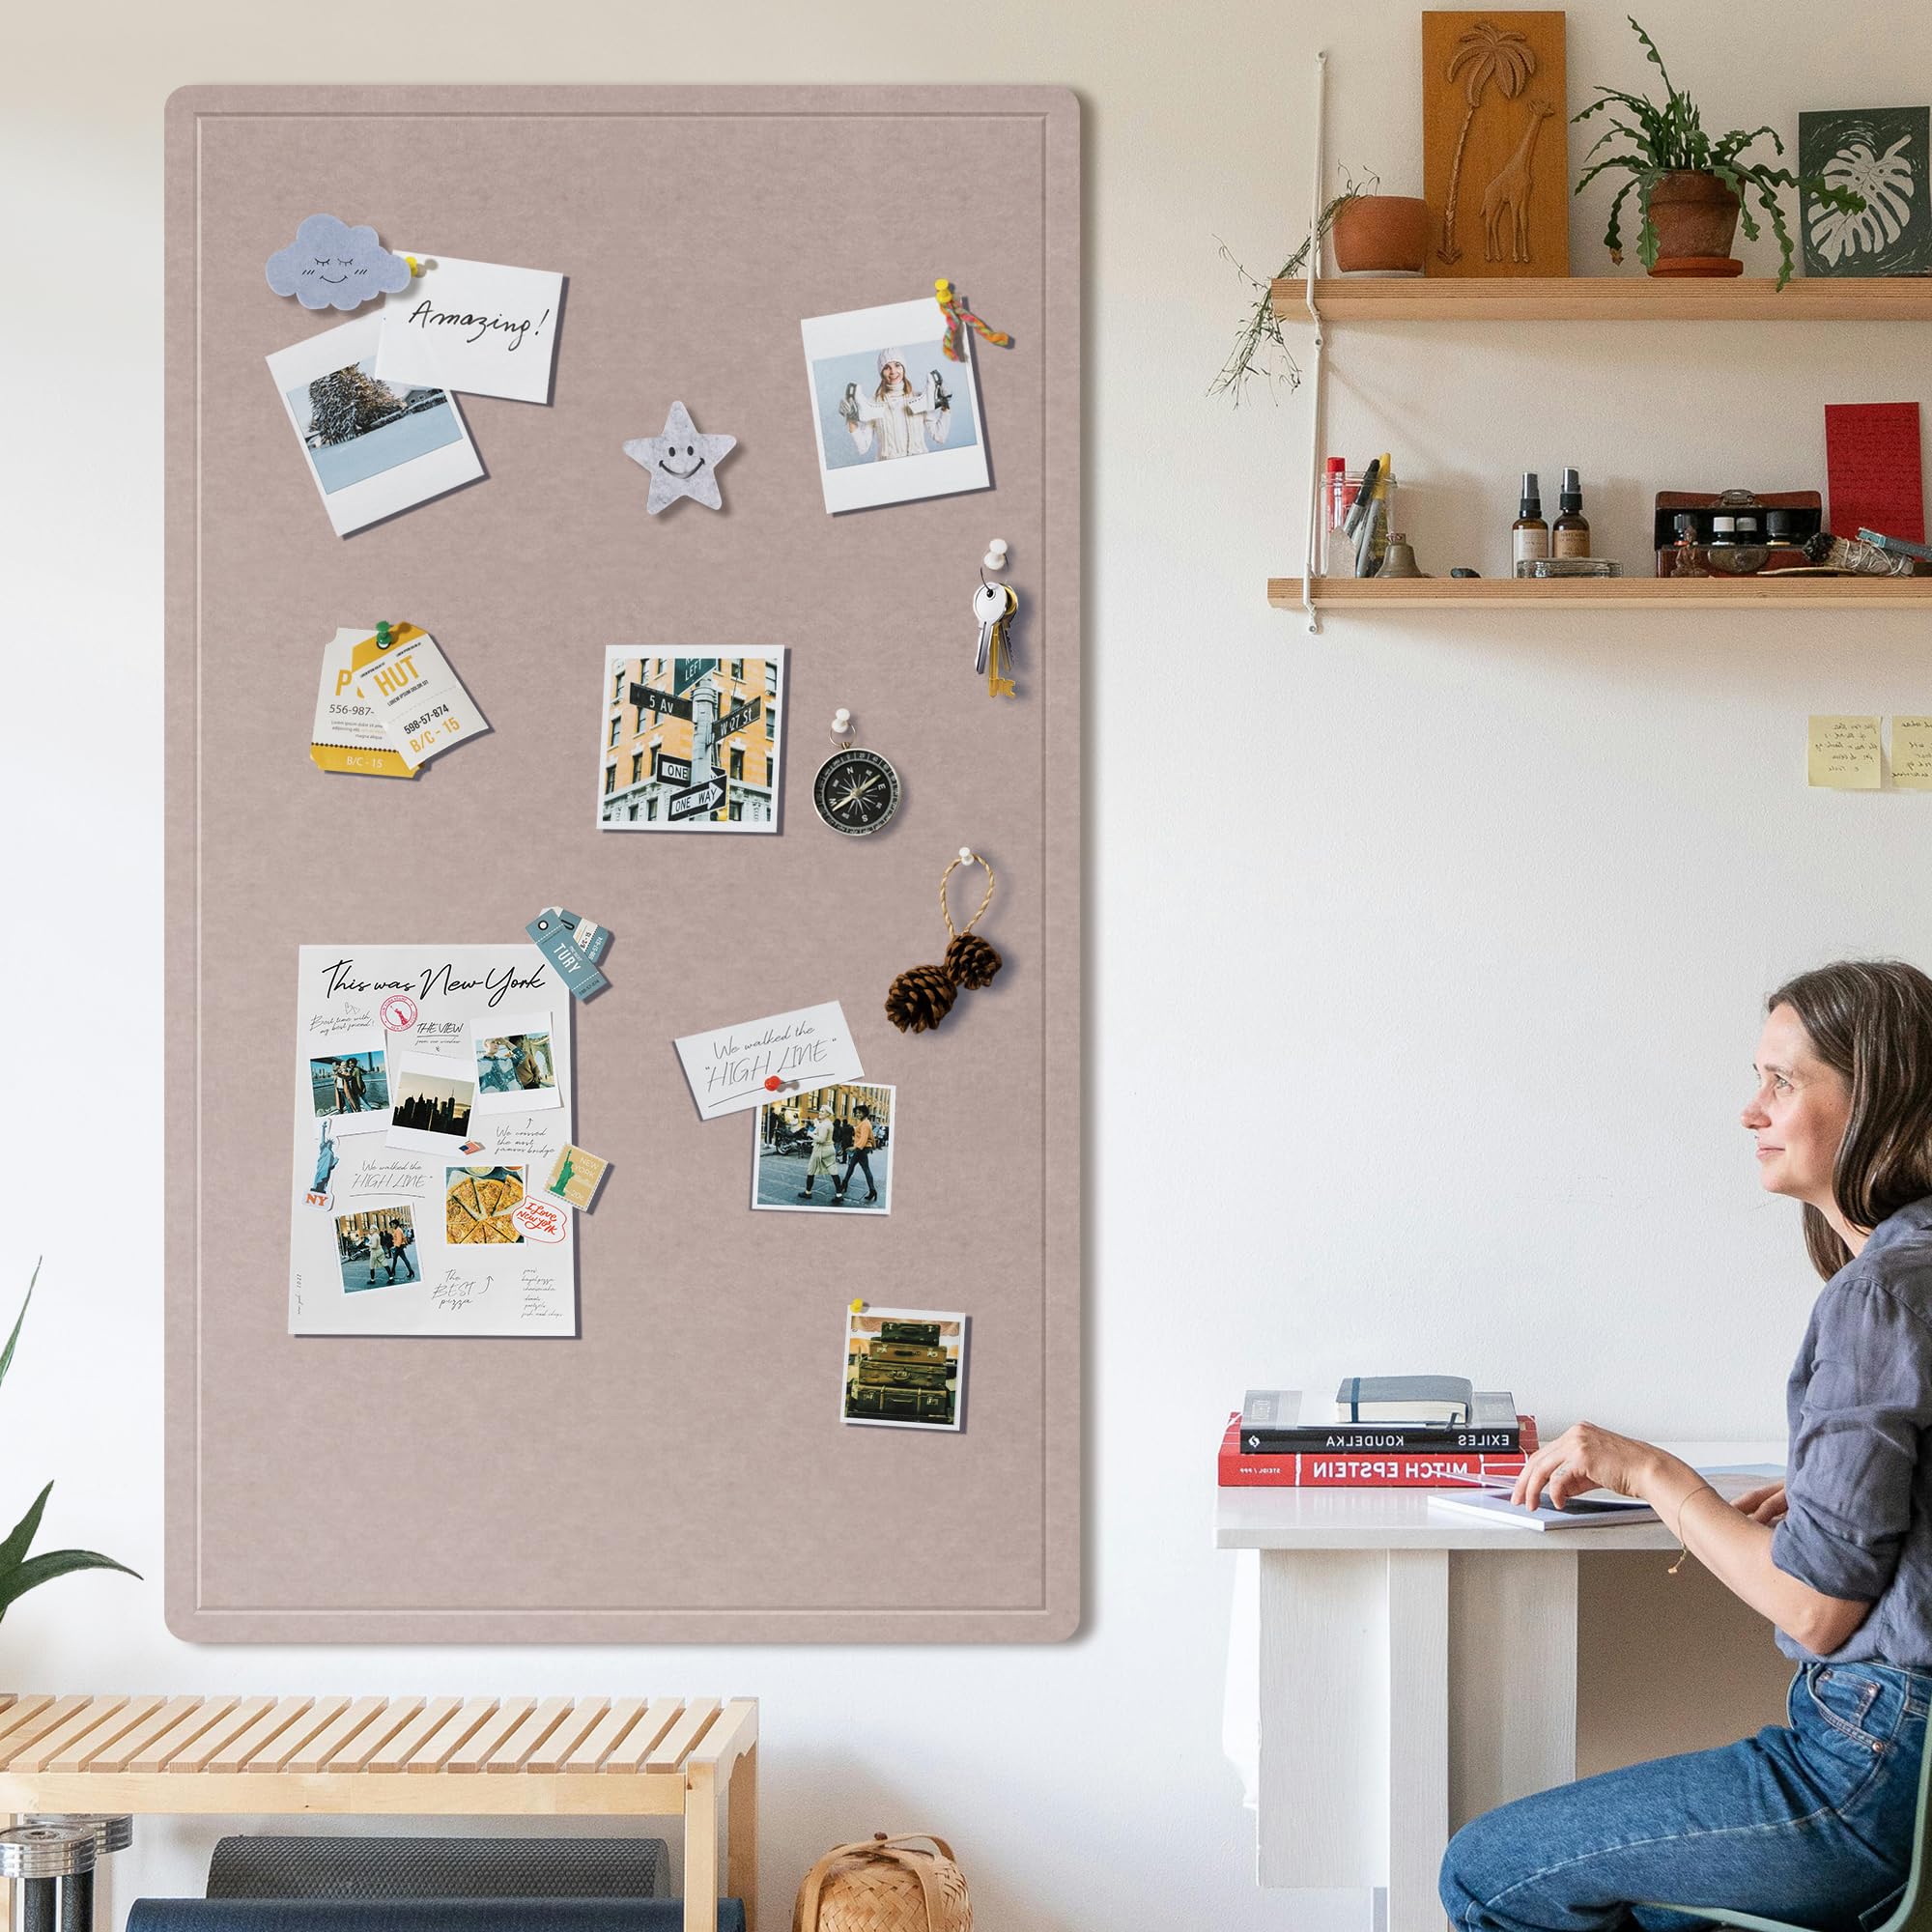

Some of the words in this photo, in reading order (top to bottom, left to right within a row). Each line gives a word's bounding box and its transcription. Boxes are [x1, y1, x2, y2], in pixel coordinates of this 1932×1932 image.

[408, 299, 550, 351] Amazing!
[373, 655, 419, 696] HUT
[685, 661, 703, 682] LEFT
[649, 695, 656, 709] 5
[660, 698, 674, 714] Av
[403, 703, 449, 735] 598-57-874
[720, 724, 728, 737] W
[729, 716, 740, 731] 27
[743, 707, 753, 725] St
[410, 730, 436, 753] B/C
[441, 717, 461, 733] 15
[347, 755, 363, 766] B/C
[372, 757, 384, 768] 15
[846, 766, 854, 775] N
[668, 765, 689, 780] ONE
[675, 796, 692, 812] ONE
[697, 787, 718, 804] WAY
[861, 814, 868, 823] S
[553, 942, 582, 974] TURY
[322, 959, 371, 999] This
[374, 980, 415, 993] was
[419, 963, 483, 1001] New
[484, 963, 546, 1008] York
[417, 1022, 439, 1034] THE
[439, 1022, 465, 1034] VIEW
[713, 1036, 740, 1060] We
[744, 1025, 792, 1051] walked
[795, 1020, 815, 1037] the
[497, 1125, 512, 1137] We
[362, 1159, 377, 1172] We
[379, 1161, 410, 1170] walked
[410, 1160, 422, 1170] the
[305, 1192, 328, 1207] NY
[517, 1211, 538, 1223] New
[531, 1206, 557, 1222] Love
[431, 1281, 477, 1300] BEST
